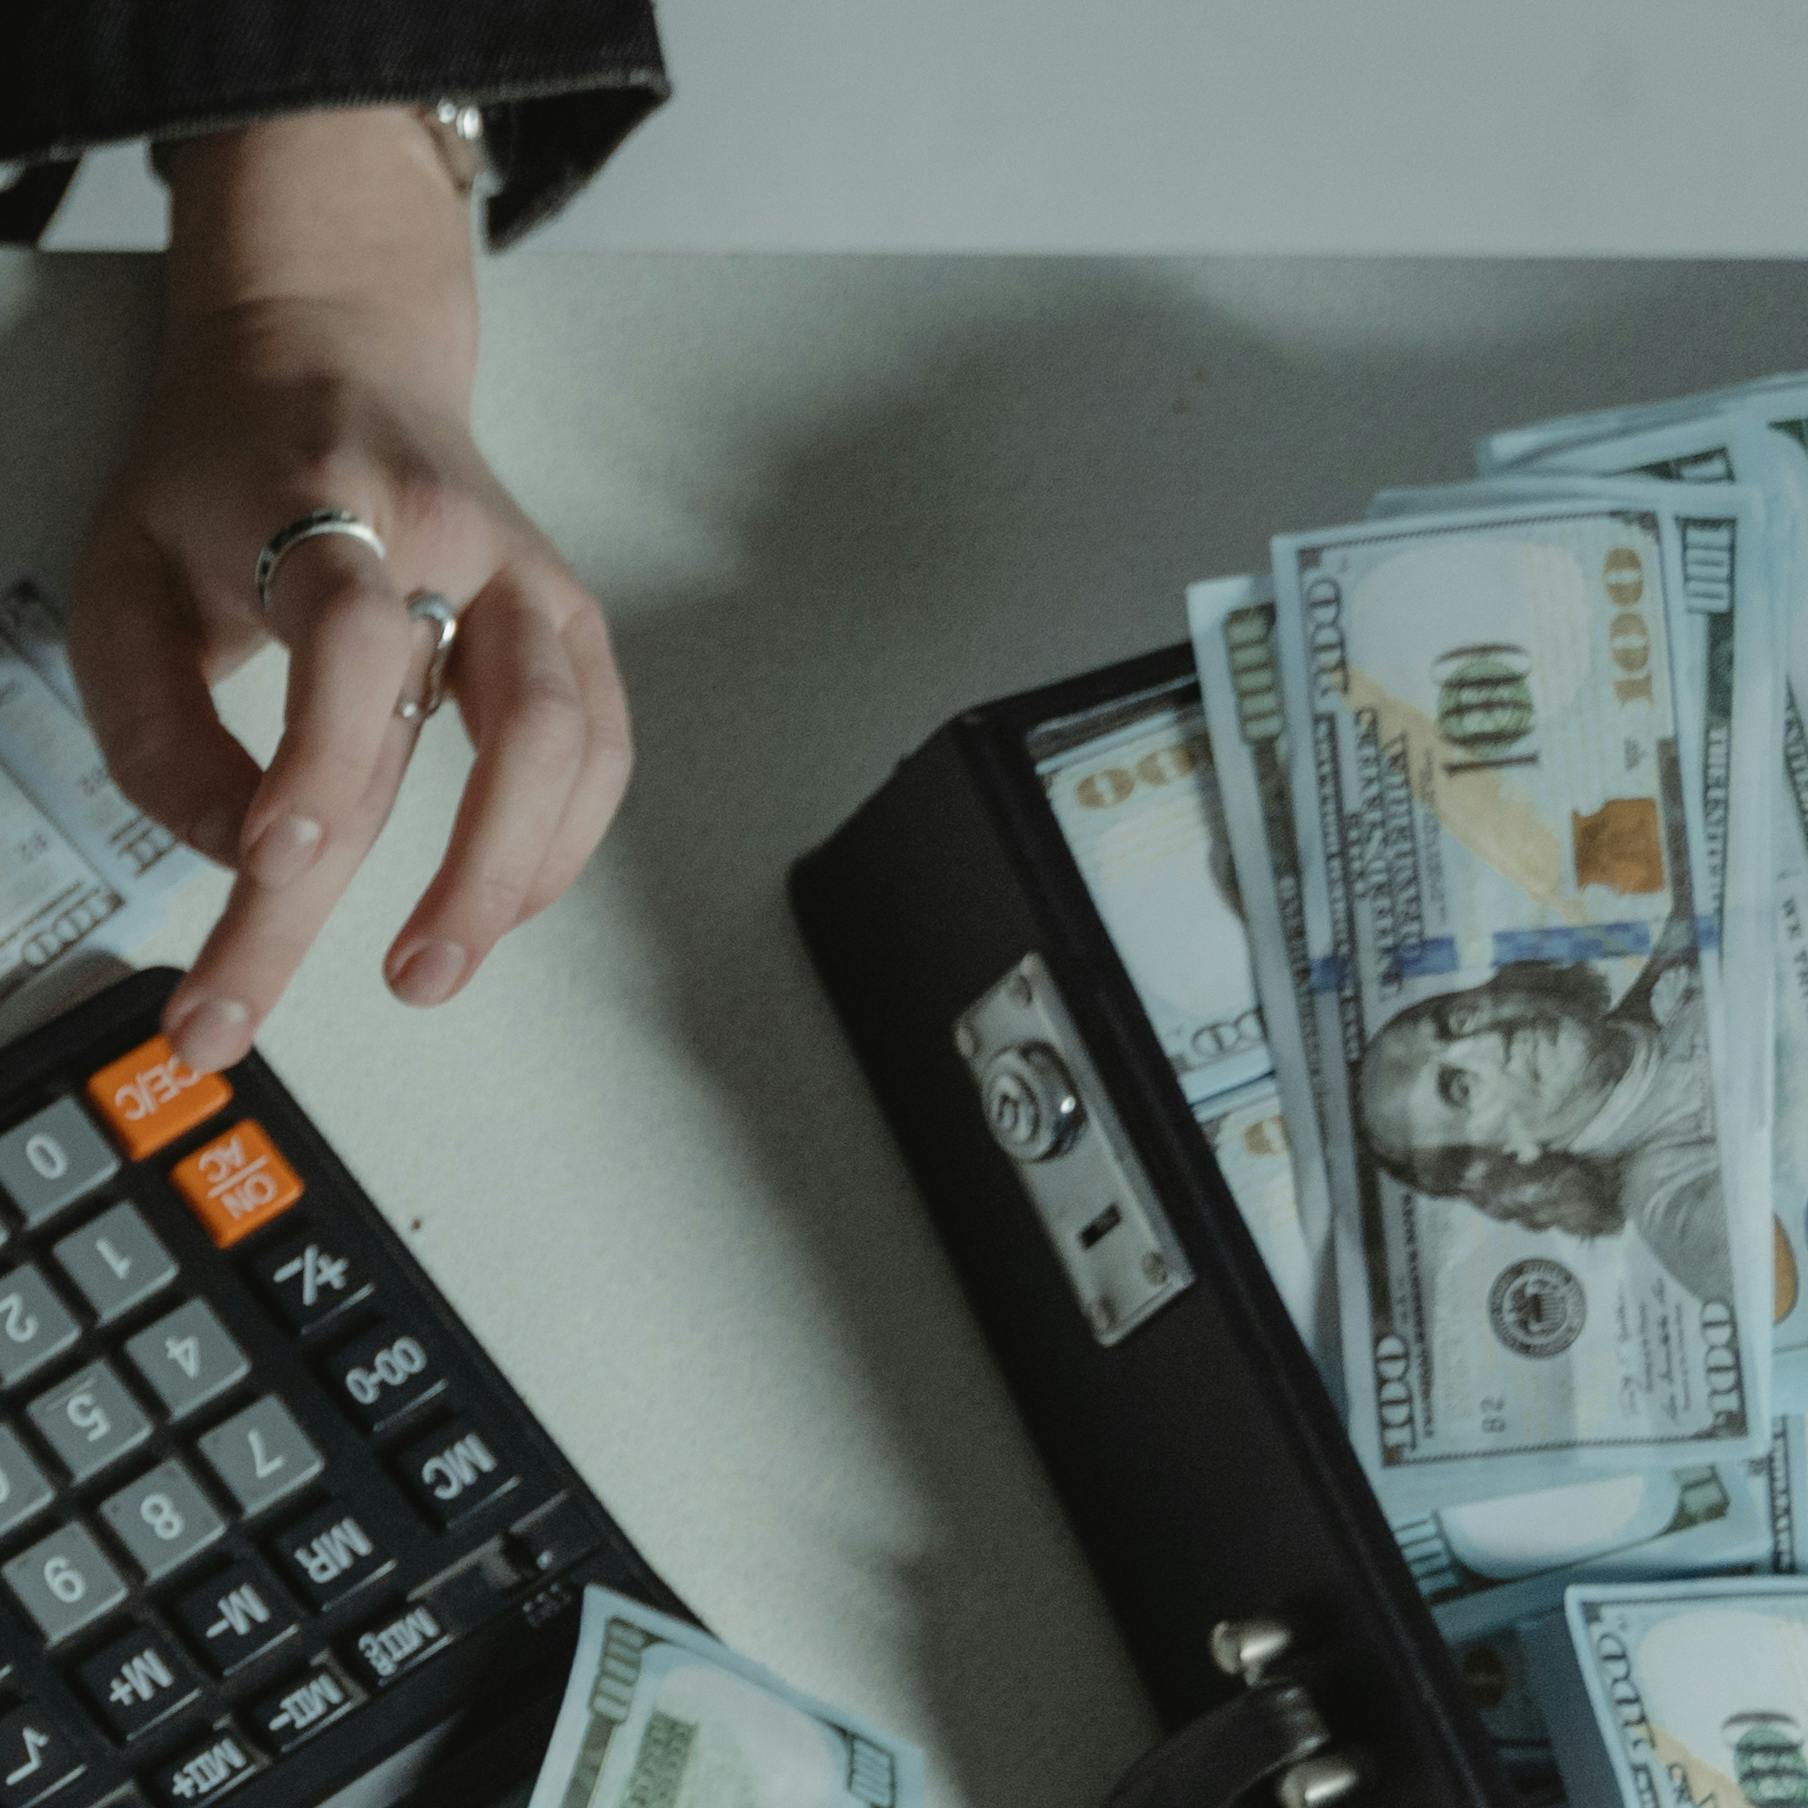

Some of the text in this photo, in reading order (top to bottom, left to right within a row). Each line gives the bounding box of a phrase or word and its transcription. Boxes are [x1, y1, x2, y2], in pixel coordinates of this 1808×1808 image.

[1307, 591, 1354, 702] 100
[1605, 549, 1655, 704] 100
[1435, 648, 1537, 782] 100
[20, 887, 123, 968] 100
[114, 1043, 199, 1120] CE/C
[24, 1134, 68, 1181] 0
[197, 1134, 244, 1185] AC
[222, 1173, 277, 1221] ON
[95, 1237, 131, 1281] 1
[164, 1332, 201, 1380] 4
[1700, 1303, 1743, 1422] 100
[68, 1393, 109, 1442] 5
[1377, 1334, 1420, 1451] 100
[247, 1428, 285, 1478] 7
[421, 1433, 496, 1499] MC
[140, 1494, 184, 1540] 8
[293, 1518, 372, 1583] MR
[42, 1557, 85, 1603] 9
[206, 1583, 271, 1639] M-
[107, 1648, 172, 1705] M+
